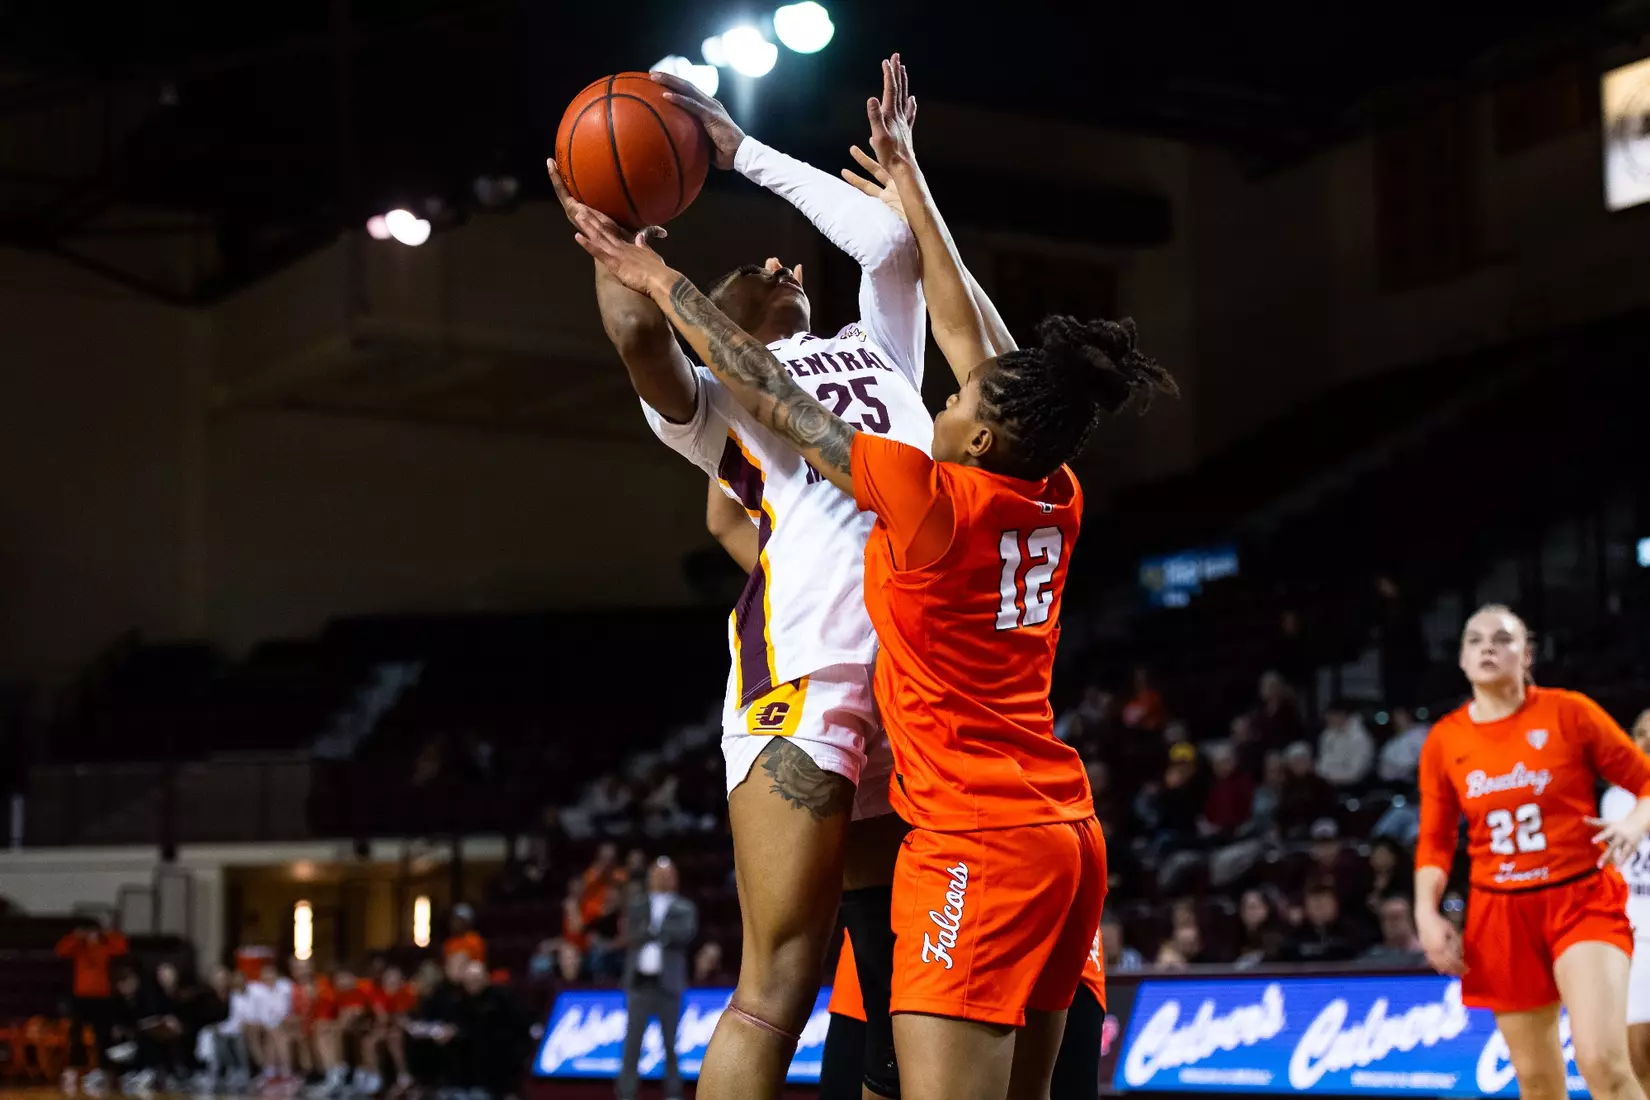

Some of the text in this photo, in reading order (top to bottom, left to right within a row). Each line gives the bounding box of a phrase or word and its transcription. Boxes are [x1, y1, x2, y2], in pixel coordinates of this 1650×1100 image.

[816, 376, 891, 434] 25
[996, 527, 1062, 630] 12
[756, 702, 790, 726] C
[1486, 804, 1546, 855] 22
[921, 862, 968, 970] Falcons
